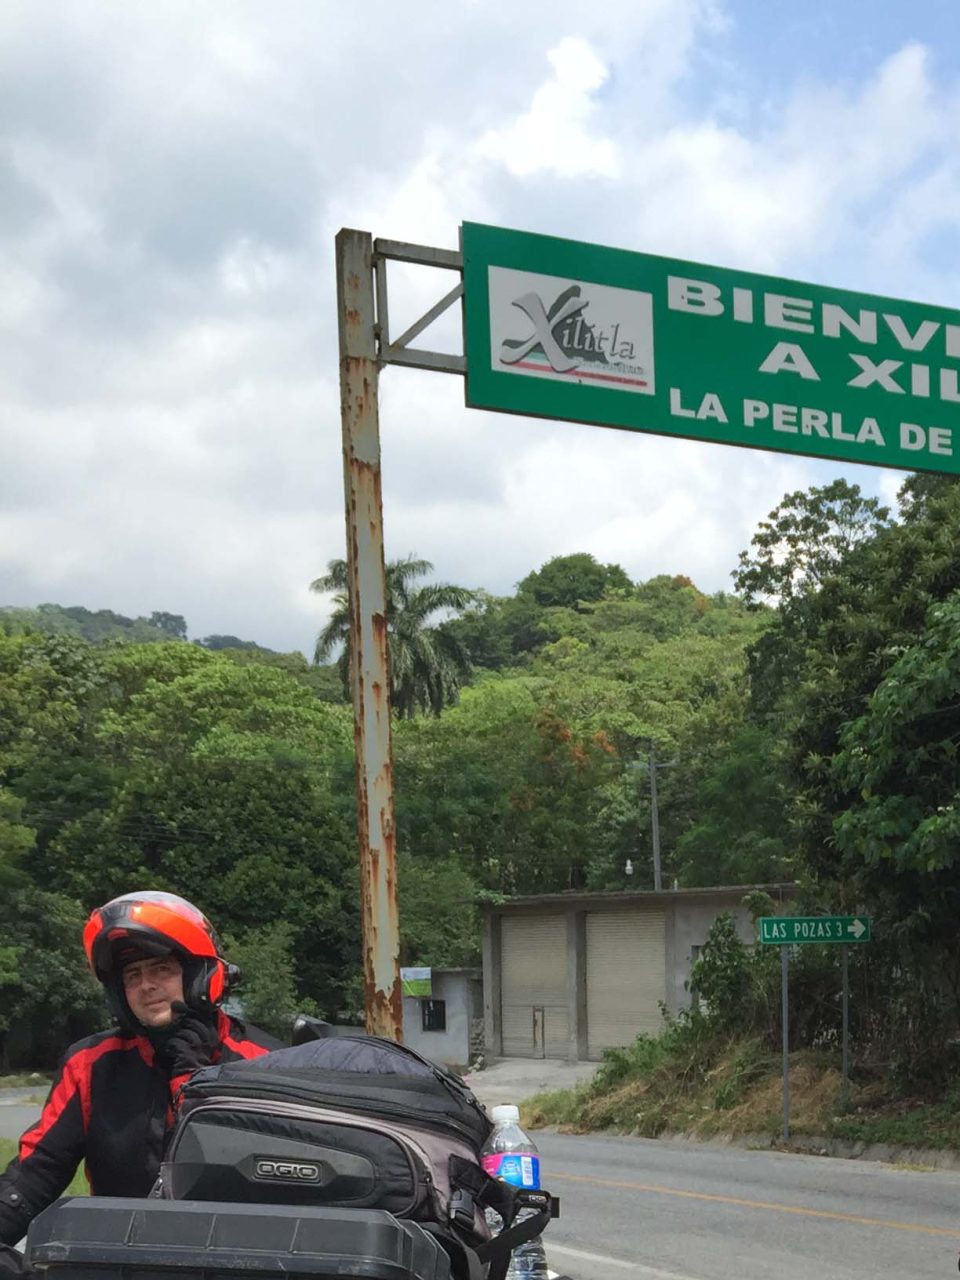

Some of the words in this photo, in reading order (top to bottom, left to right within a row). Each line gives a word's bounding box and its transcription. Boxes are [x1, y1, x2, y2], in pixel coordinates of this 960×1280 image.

[499, 285, 637, 374] Xilitla
[759, 342, 820, 381] A
[669, 388, 728, 423] LA
[743, 399, 884, 446] PERLA
[900, 422, 953, 456] DE
[763, 923, 787, 938] LAS
[794, 922, 832, 938] POZAS
[835, 922, 843, 936] 3
[257, 1161, 319, 1179] OGIO
